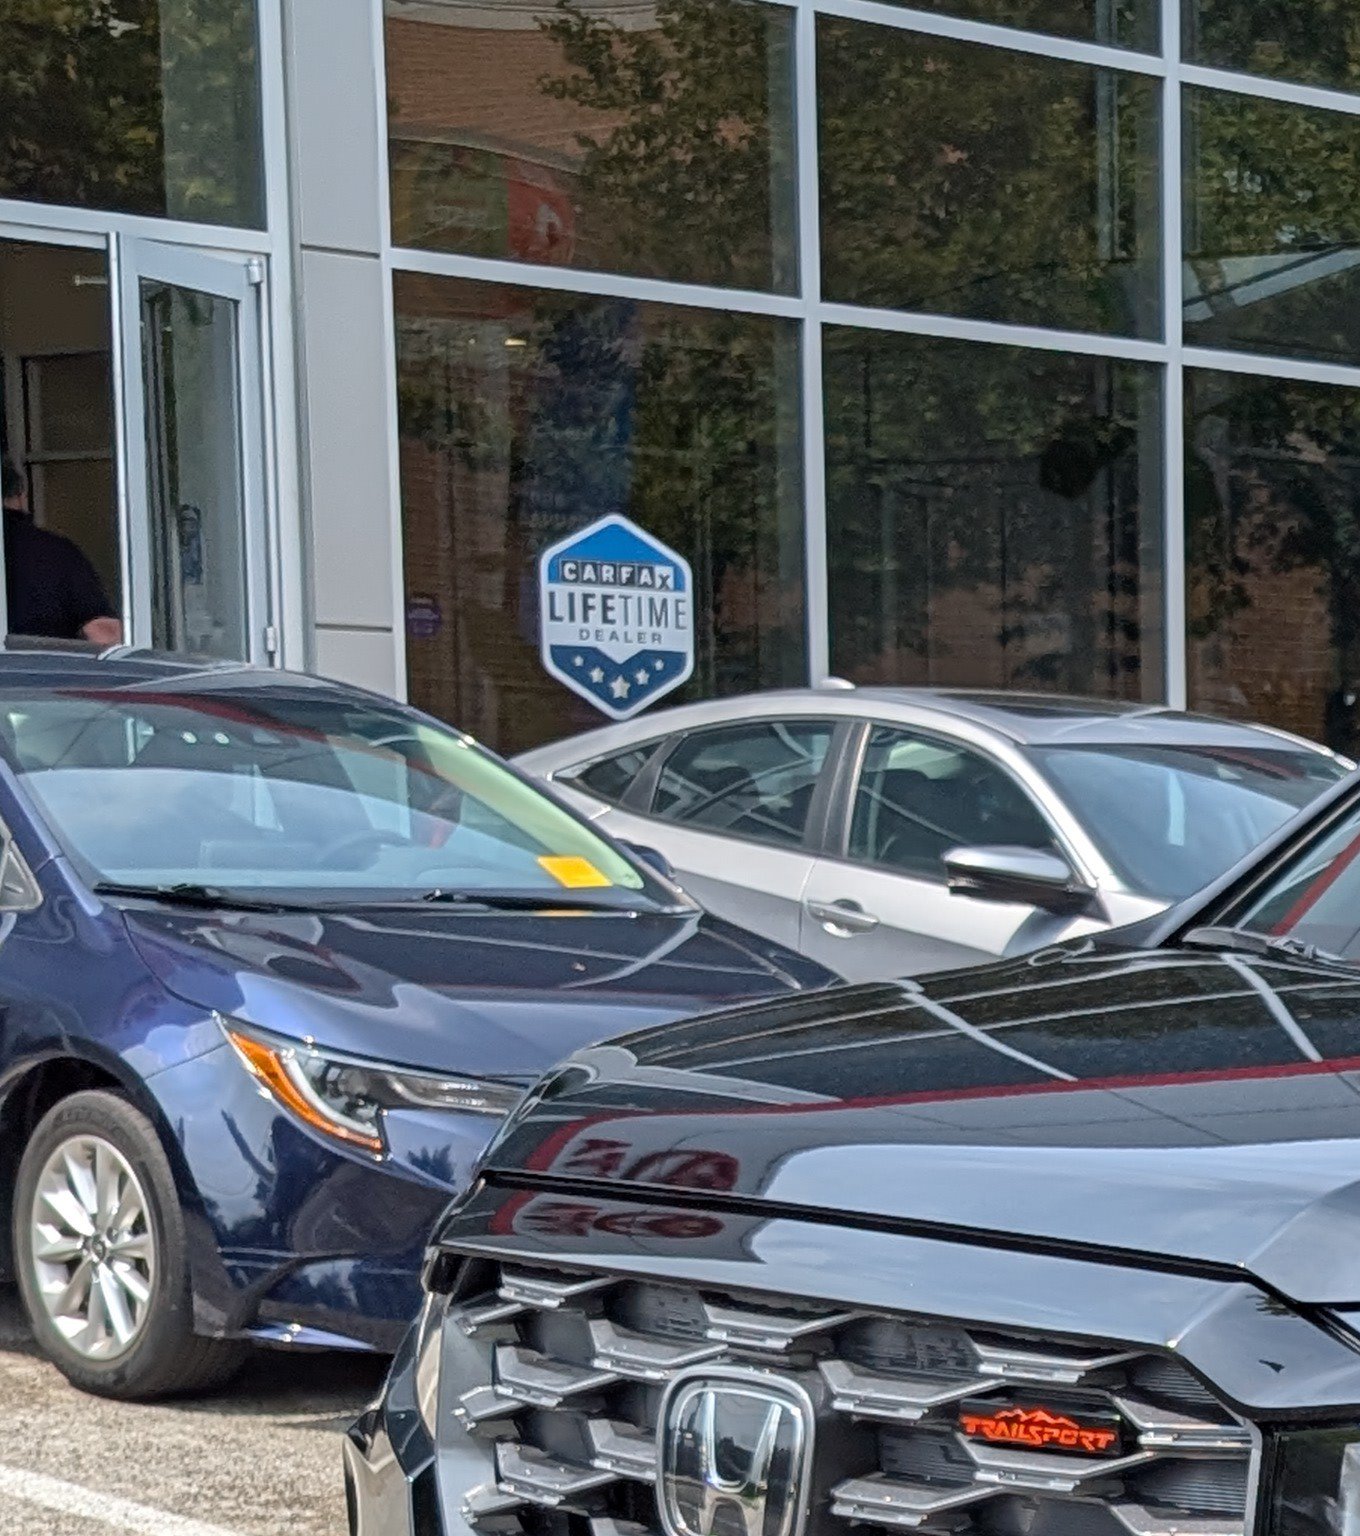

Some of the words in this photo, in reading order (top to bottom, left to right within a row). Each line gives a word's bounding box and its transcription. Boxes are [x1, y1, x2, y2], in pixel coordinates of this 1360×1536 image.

[562, 561, 673, 590] CARFAX
[548, 591, 688, 630] LIFETIME
[578, 629, 663, 644] DEALER
[961, 1414, 1116, 1451] TRAILSPORT
